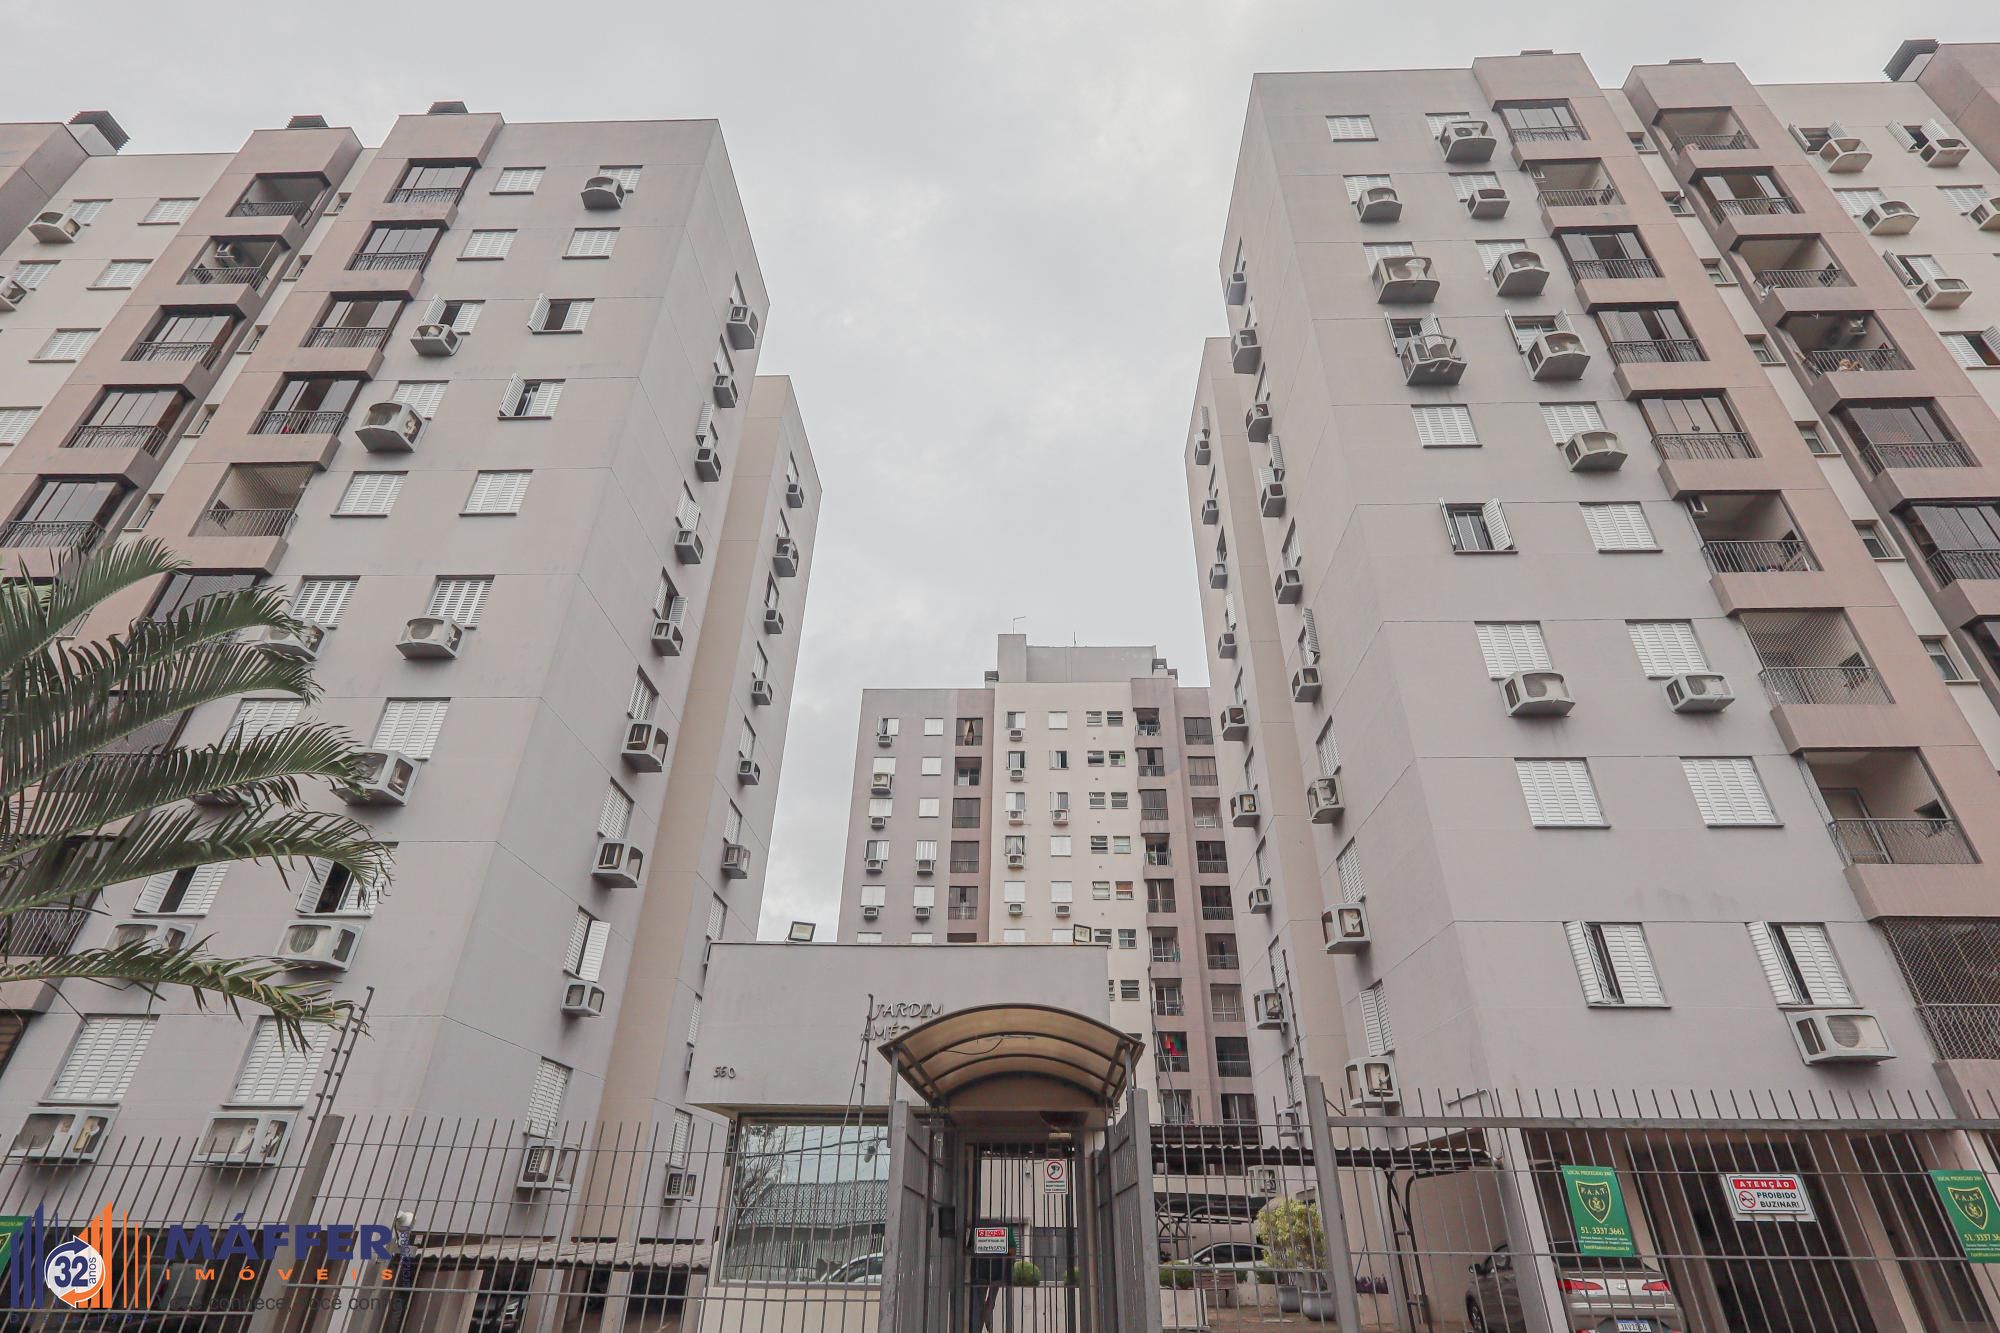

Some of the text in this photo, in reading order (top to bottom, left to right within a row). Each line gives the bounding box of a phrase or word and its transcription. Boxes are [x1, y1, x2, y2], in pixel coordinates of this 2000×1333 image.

[872, 1002, 944, 1021] JARDIM
[861, 1022, 910, 1041] AMÉ
[1740, 1180, 1790, 1189] ATENÇÃO
[1757, 1191, 1797, 1199] PROIBIDO
[1759, 1201, 1800, 1209] BUZINAR!
